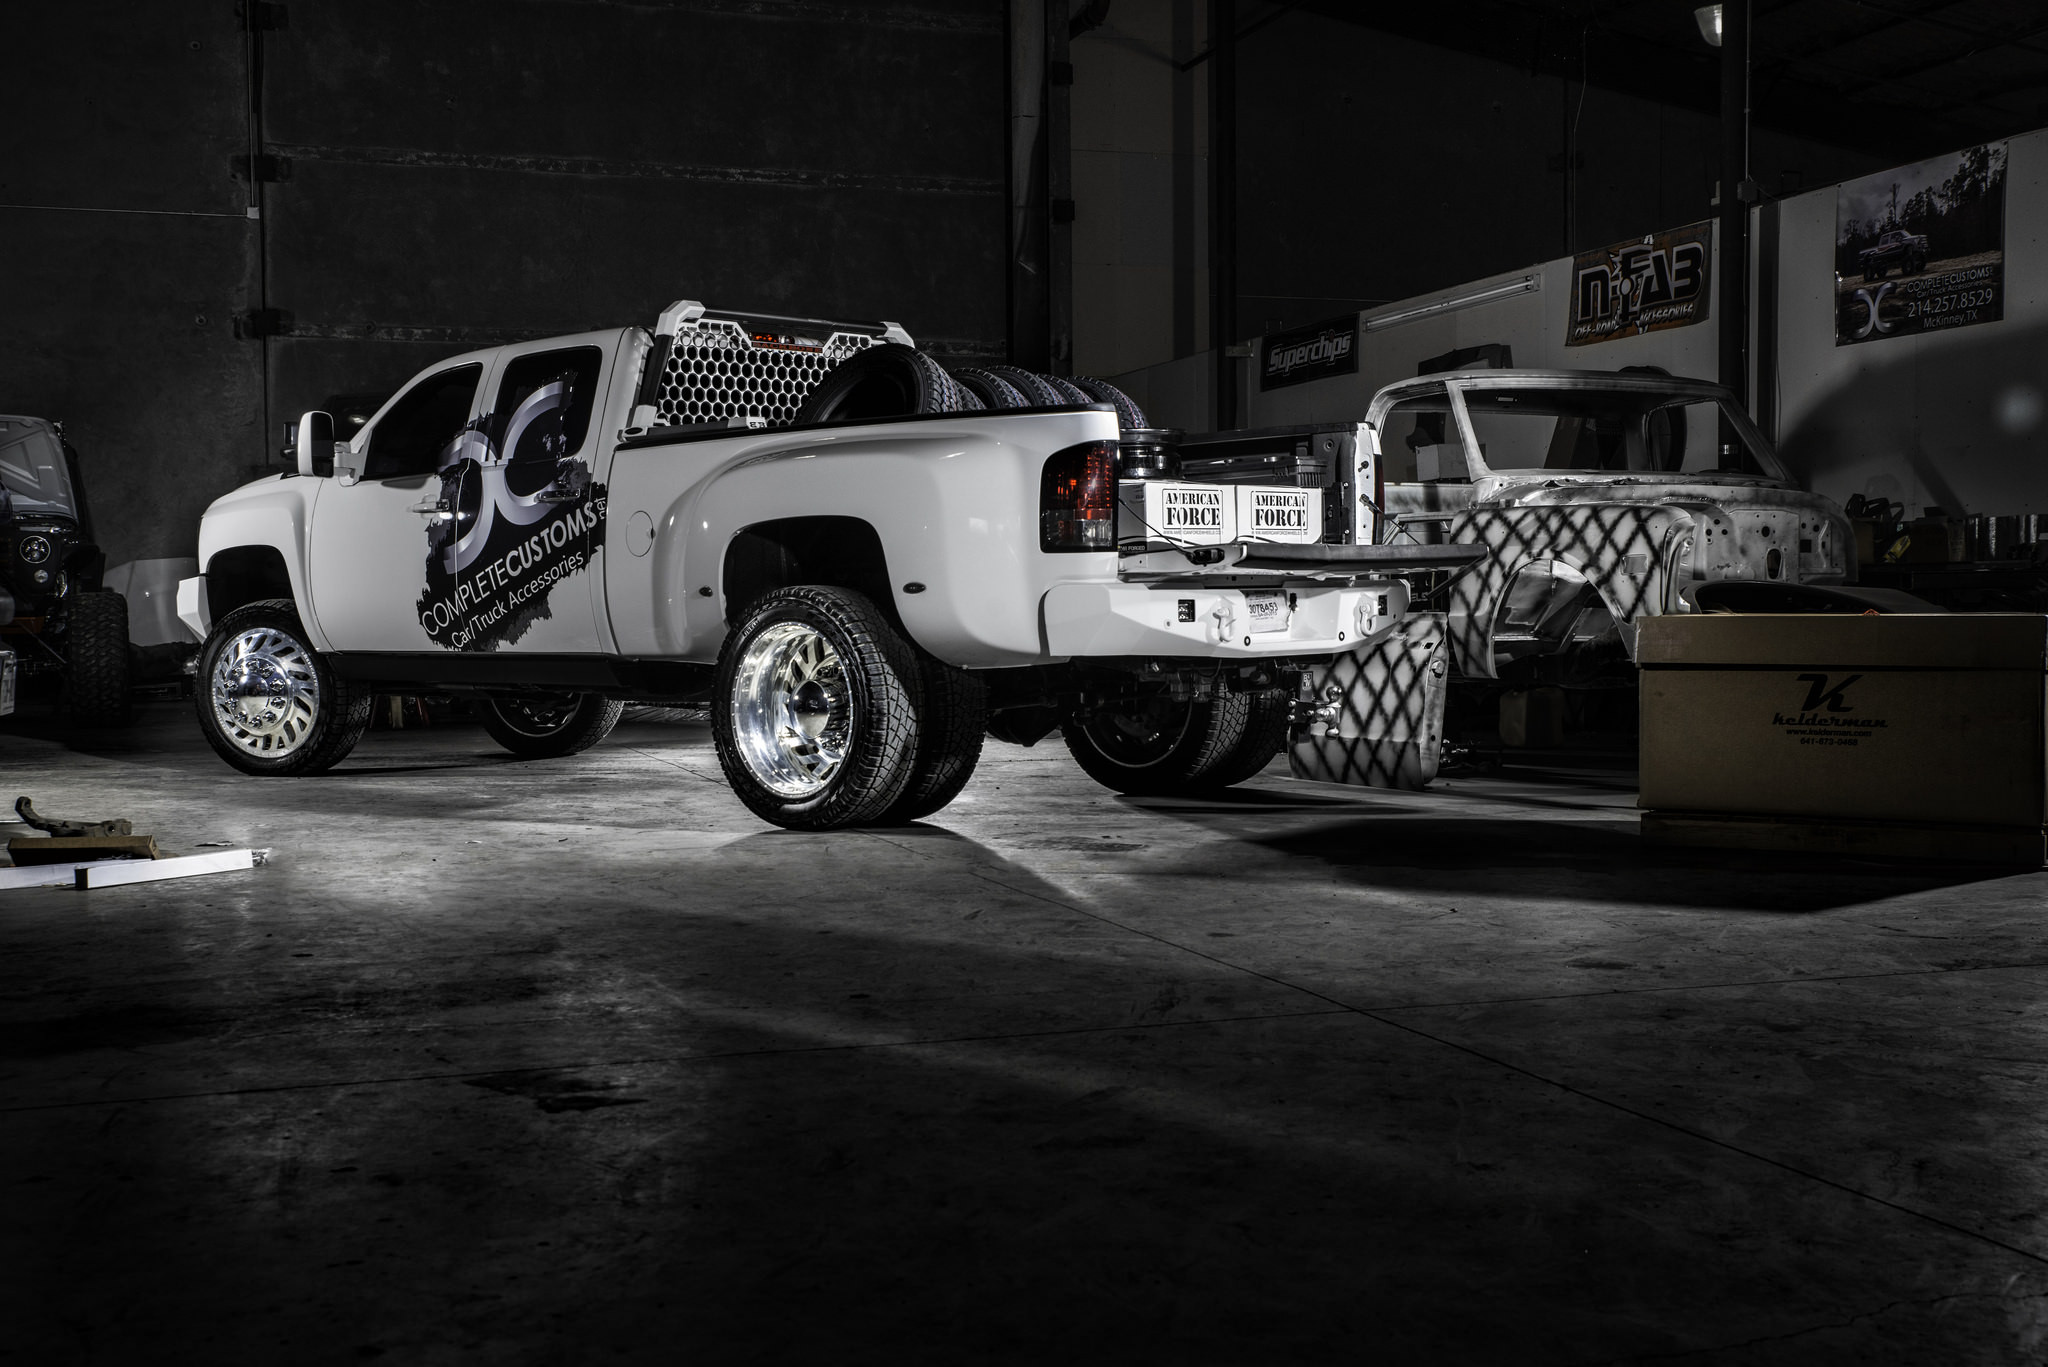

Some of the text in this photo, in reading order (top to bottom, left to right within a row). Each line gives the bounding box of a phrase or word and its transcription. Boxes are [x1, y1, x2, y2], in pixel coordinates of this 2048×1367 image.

[1947, 281, 1983, 292] Accessories
[1908, 288, 1993, 317] 214.257.8529
[1639, 303, 1694, 326] ACCESSORIES
[1267, 329, 1353, 375] Superchips
[1165, 493, 1220, 505] AMERICAN
[1255, 495, 1306, 507] AMERICAN
[1166, 507, 1221, 526] FORCE
[1255, 509, 1306, 527] FORCE
[451, 551, 585, 649] Car/Truck Accessories
[1797, 674, 1864, 712] K
[1772, 713, 1889, 728] kelderman
